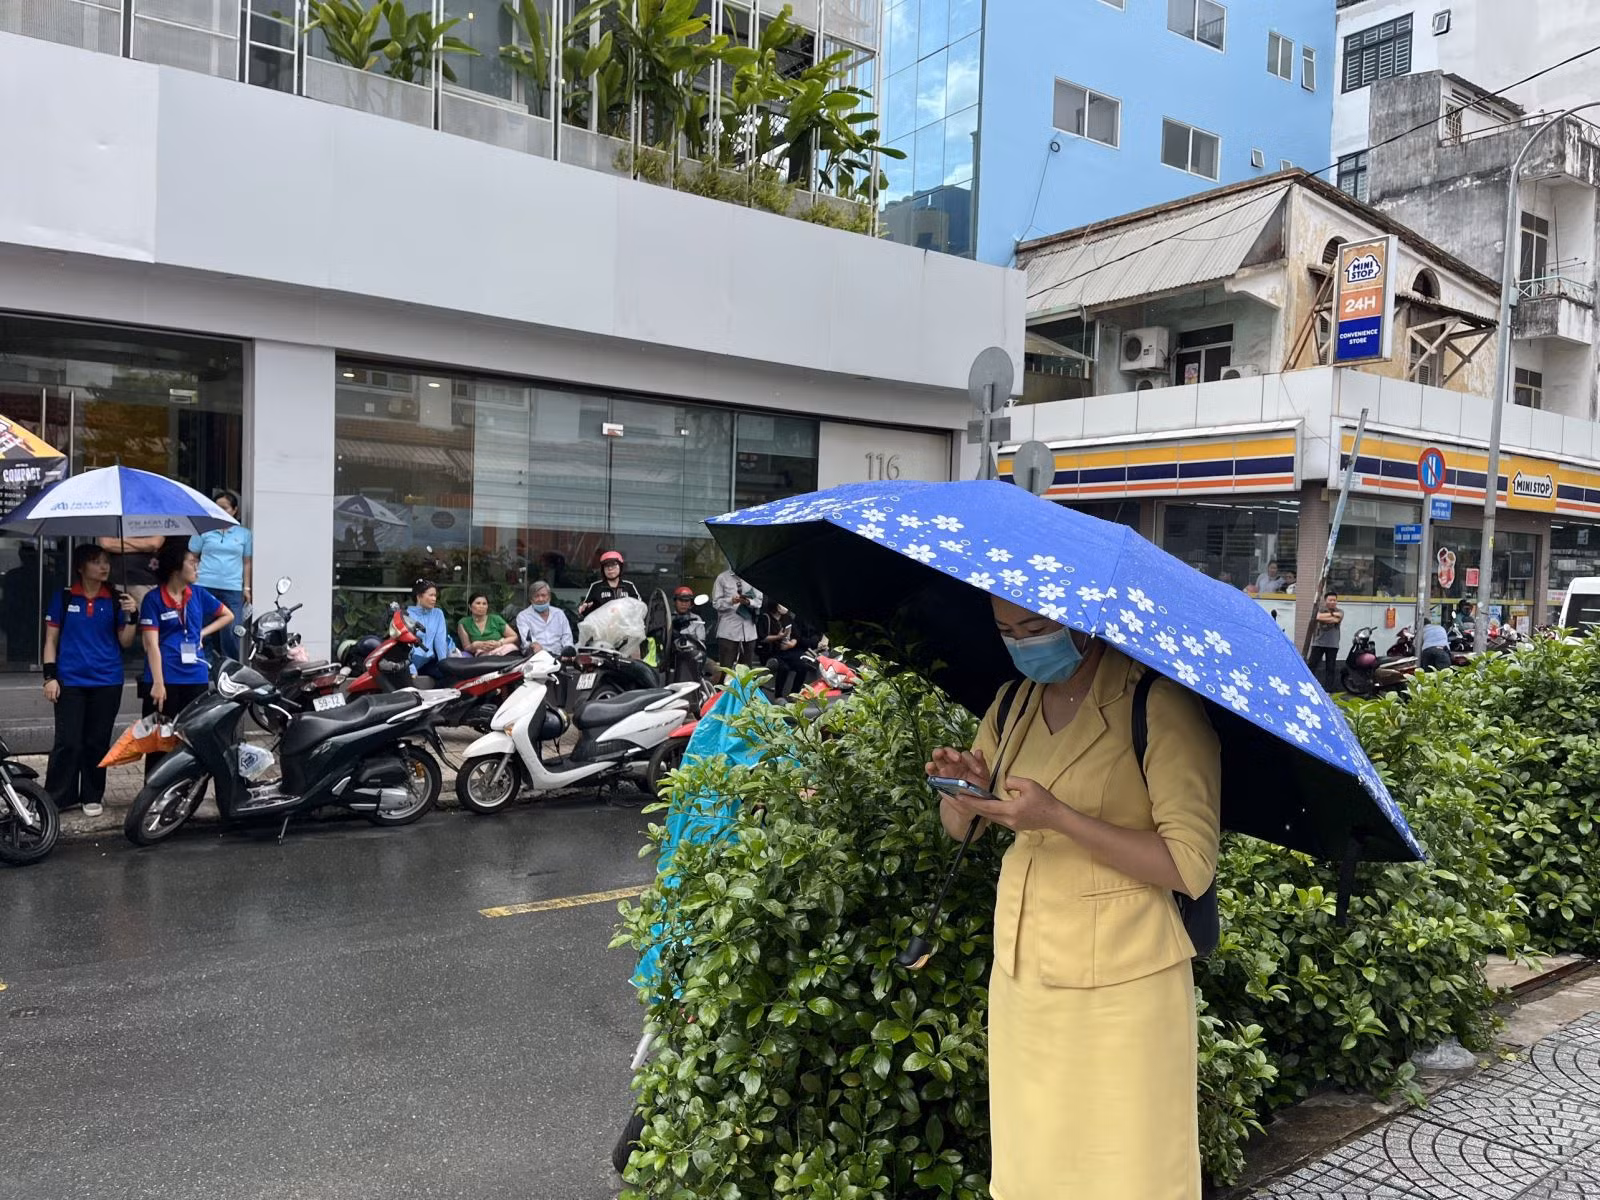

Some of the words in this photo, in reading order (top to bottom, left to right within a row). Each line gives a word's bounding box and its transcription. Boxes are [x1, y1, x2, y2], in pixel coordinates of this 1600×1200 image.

[1352, 261, 1373, 272] MINI
[1351, 269, 1374, 280] STOP
[1344, 295, 1376, 313] 24H
[1339, 328, 1379, 339] CONVENIENCE
[1348, 337, 1367, 345] STORE
[865, 452, 900, 480] 116
[2, 467, 41, 482] COMPACT
